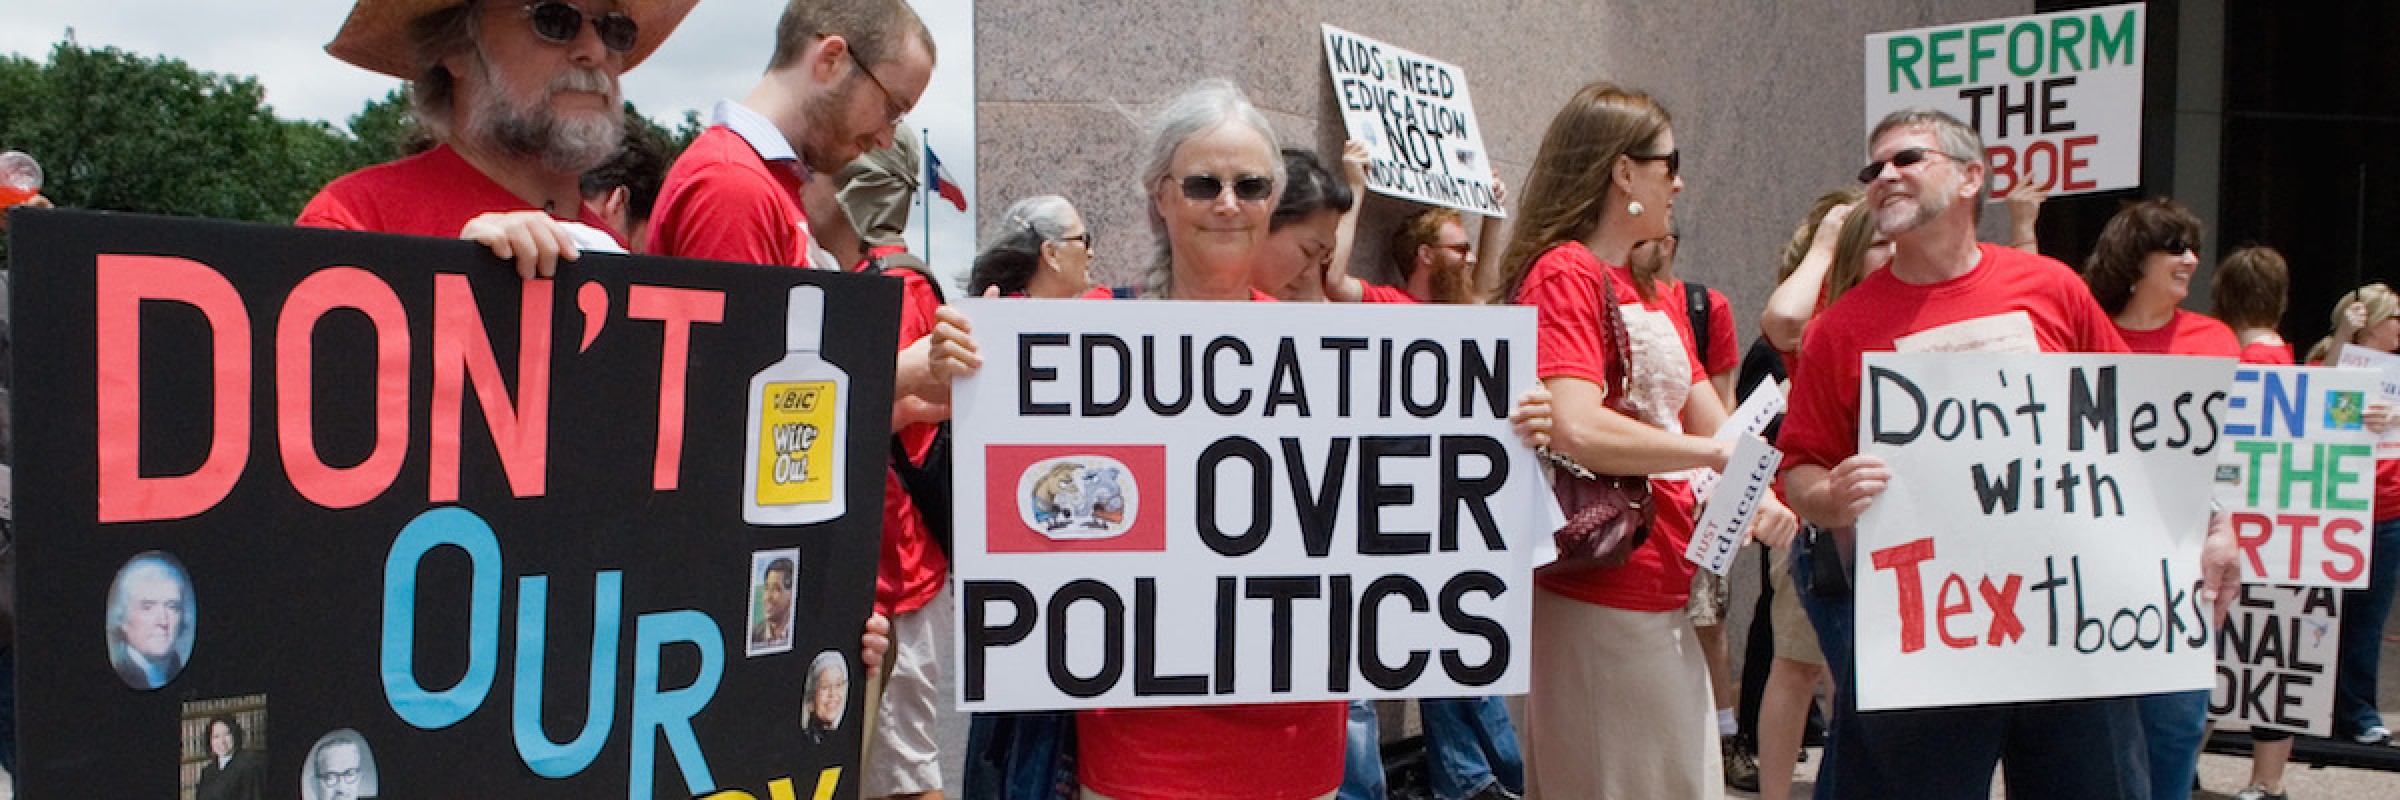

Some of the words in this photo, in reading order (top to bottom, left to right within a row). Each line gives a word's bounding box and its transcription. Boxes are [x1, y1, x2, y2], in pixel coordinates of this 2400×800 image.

[1329, 33, 1385, 82] KIDS
[1398, 56, 1455, 99] NEED
[1888, 9, 2136, 93] REFORM
[1342, 77, 1468, 140] EDUCATION
[1380, 110, 1450, 176] NOT
[1958, 76, 2077, 139] THE
[1370, 157, 1502, 215] NDOCTRINATION
[96, 253, 726, 524] DON'T
[1017, 334, 1511, 419] EDUCATION
[1869, 366, 2047, 446] Don't
[2068, 366, 2227, 456] Mess
[1196, 434, 1510, 557] OVER
[2234, 439, 2373, 511] THE
[962, 570, 1511, 703] POLITICS
[1870, 536, 2208, 656] Textbooks
[380, 507, 725, 800] OUR
